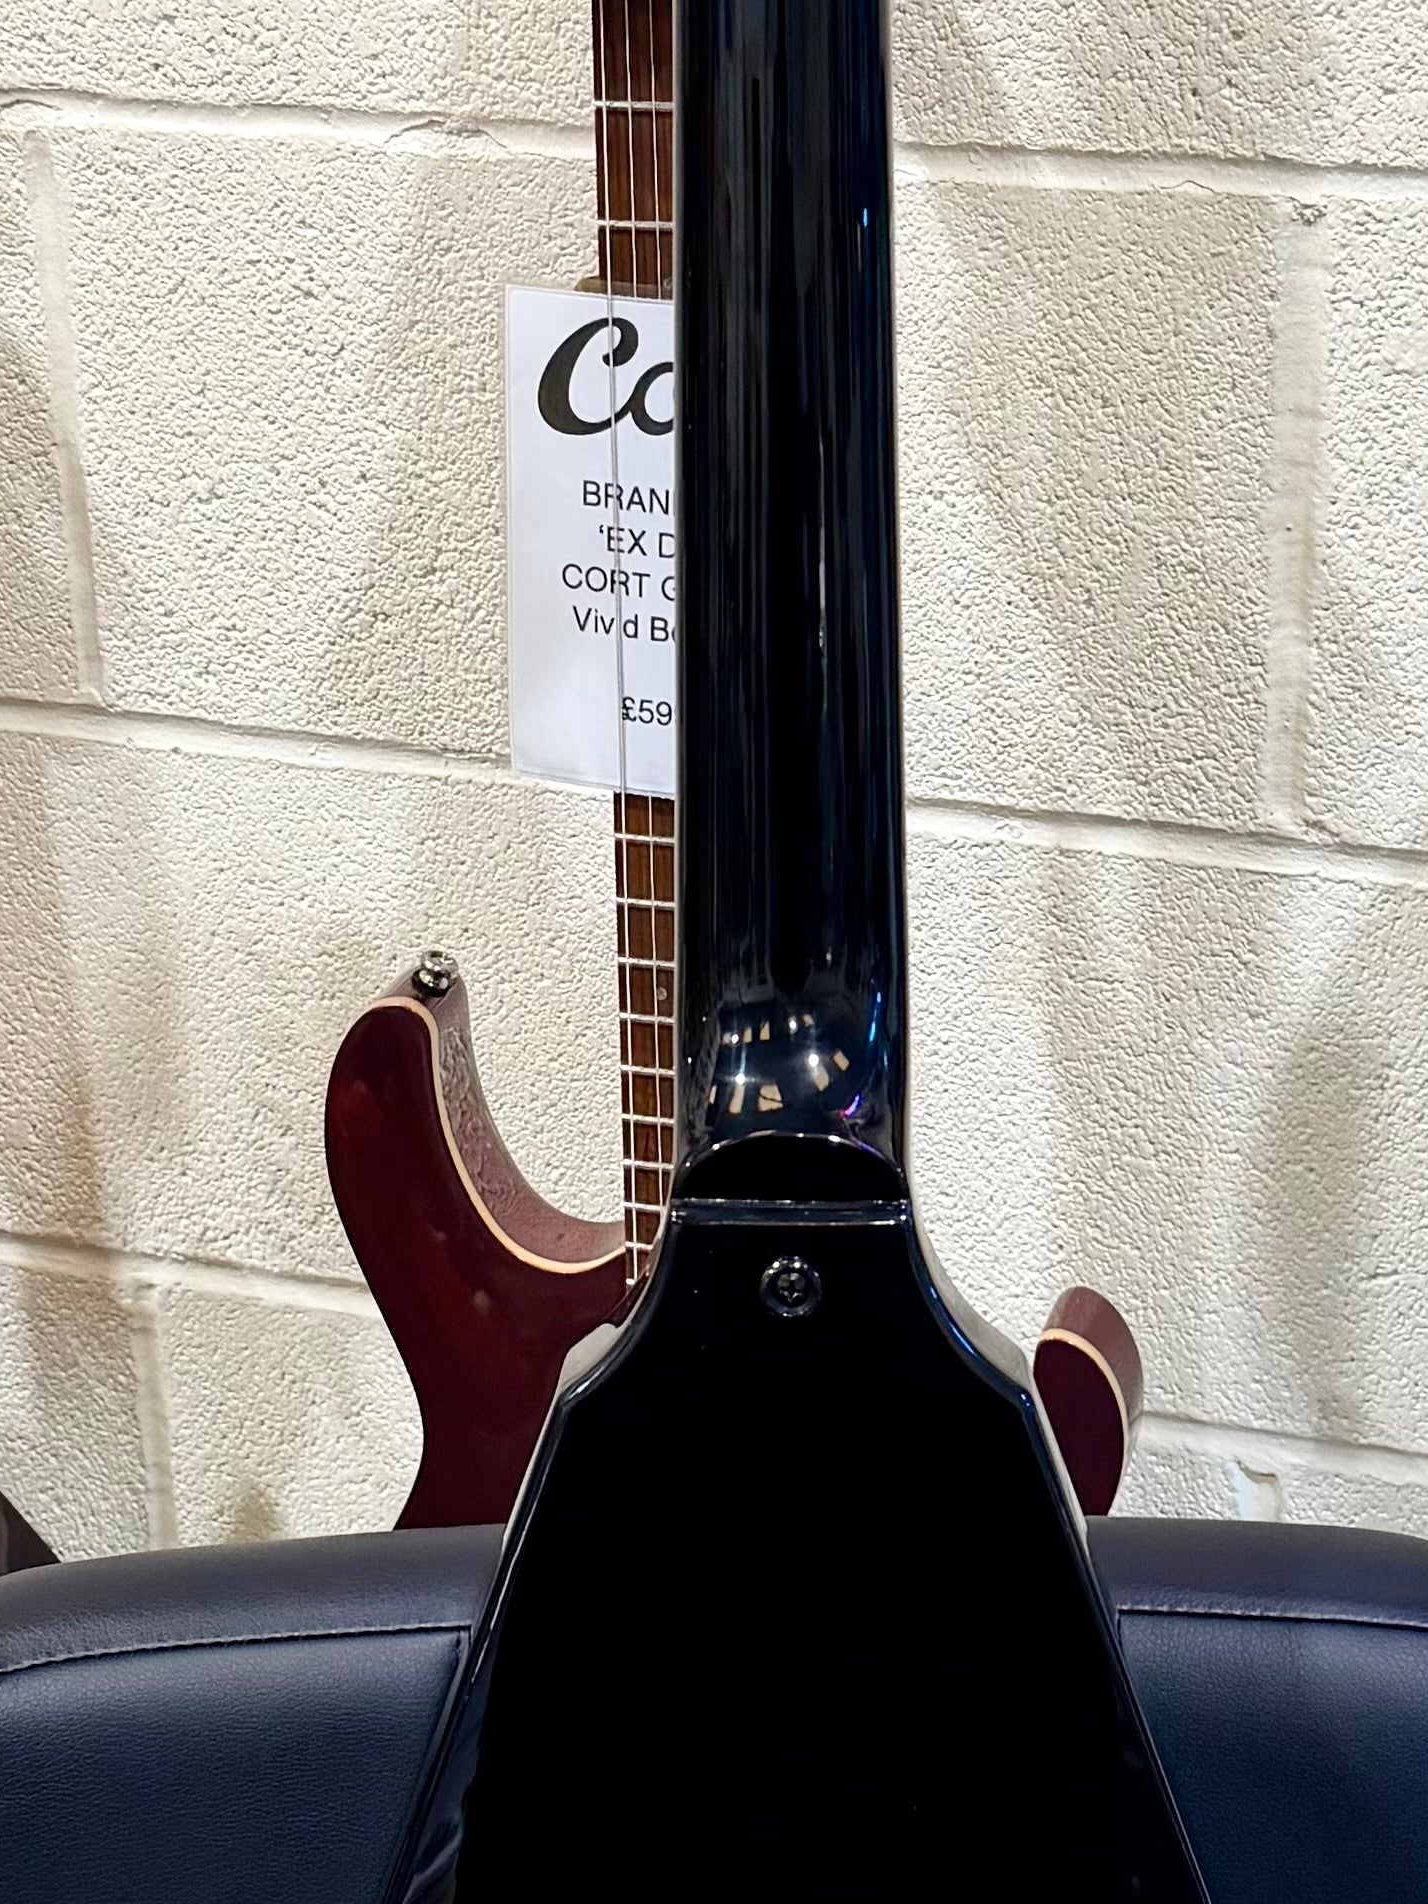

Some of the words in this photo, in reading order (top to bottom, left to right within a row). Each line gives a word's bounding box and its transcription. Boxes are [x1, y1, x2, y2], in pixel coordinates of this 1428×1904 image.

[562, 563, 651, 598] CORT
[573, 605, 638, 639] Vivd
[622, 696, 672, 726] £59
